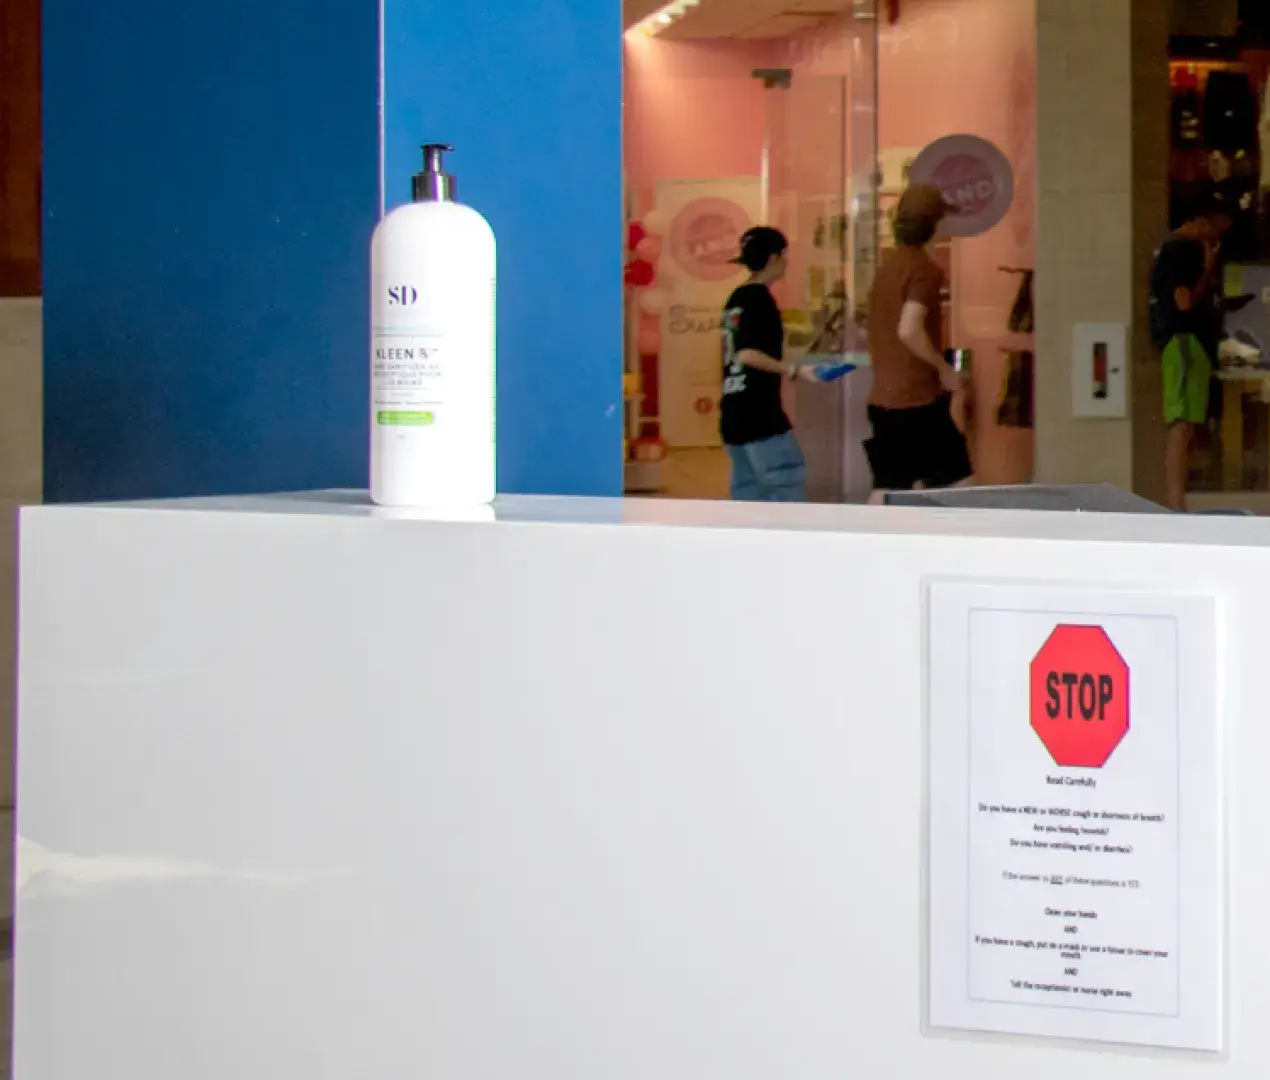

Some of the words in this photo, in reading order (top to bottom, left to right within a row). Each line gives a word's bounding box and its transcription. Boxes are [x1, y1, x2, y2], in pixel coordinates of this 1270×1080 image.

[387, 285, 418, 306] SD
[1046, 672, 1113, 721] STOP
[1046, 775, 1064, 785] Read
[1065, 776, 1097, 790] Carefully
